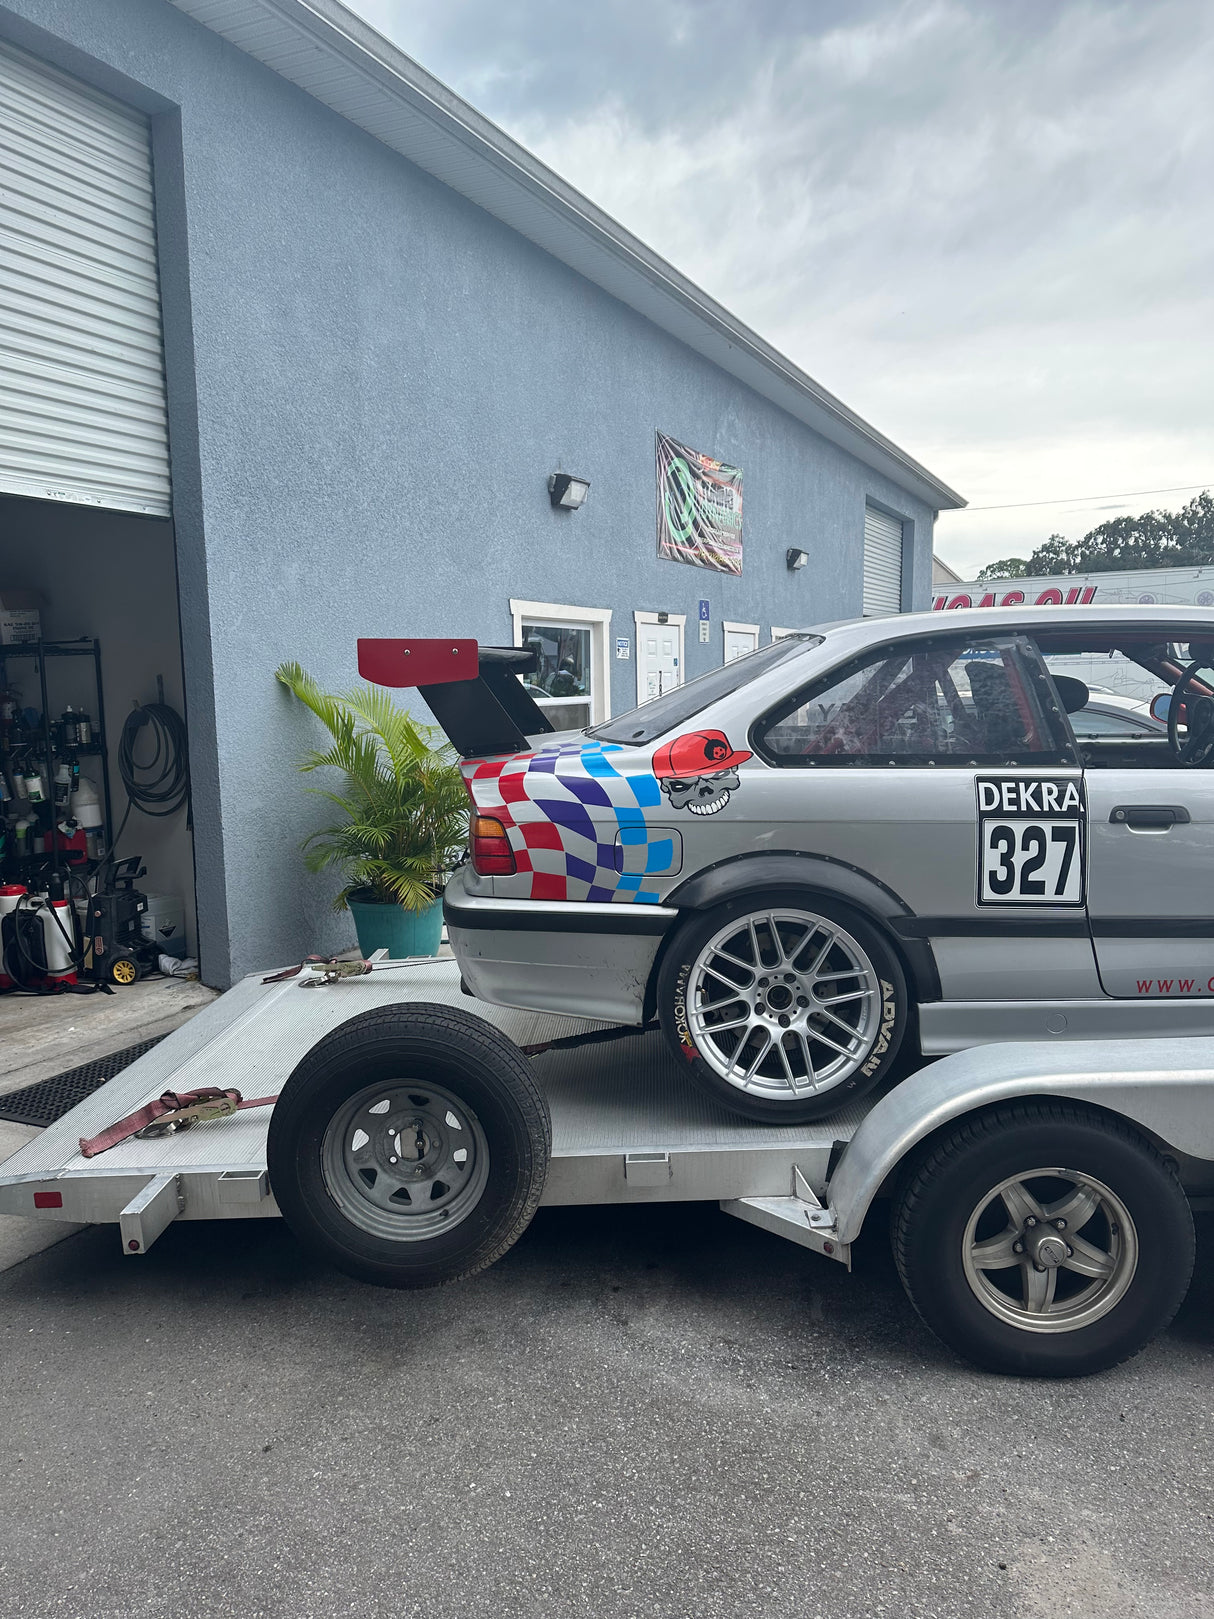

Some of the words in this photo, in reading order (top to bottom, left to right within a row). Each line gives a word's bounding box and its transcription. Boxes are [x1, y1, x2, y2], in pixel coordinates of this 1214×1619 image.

[978, 782, 1085, 812] DEKRA
[988, 825, 1077, 896] 327
[674, 964, 692, 1044] YOKOHAMA
[860, 978, 896, 1078] ADVAN
